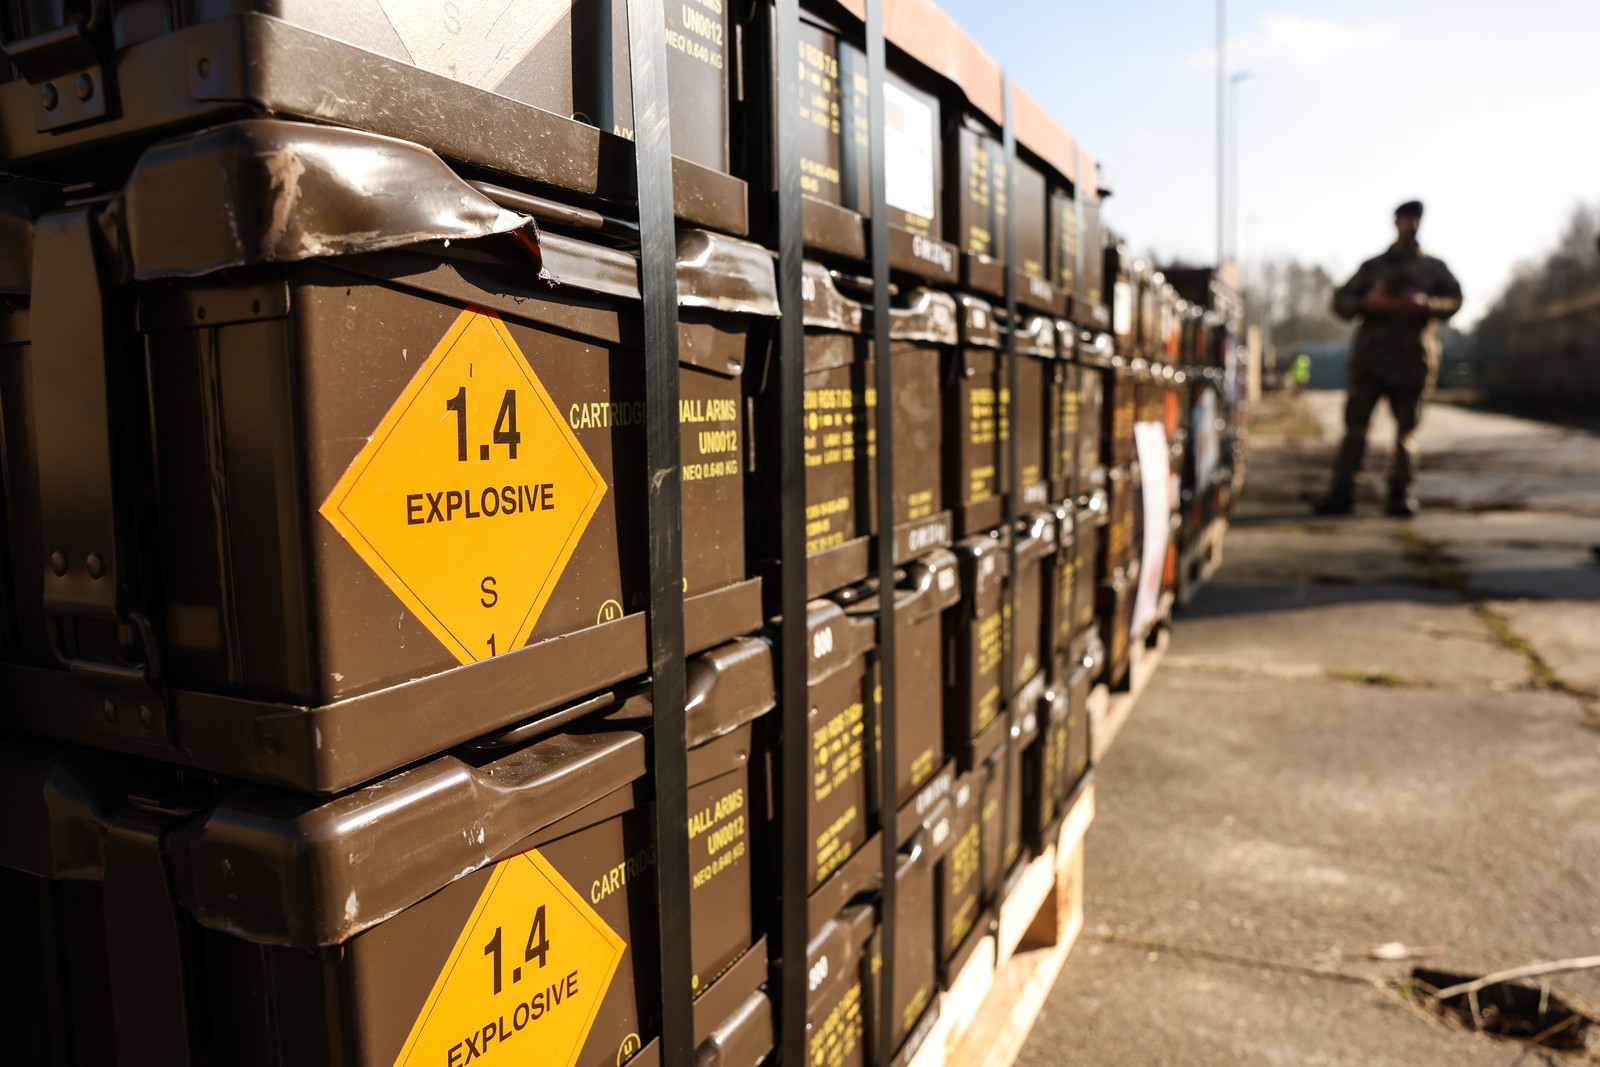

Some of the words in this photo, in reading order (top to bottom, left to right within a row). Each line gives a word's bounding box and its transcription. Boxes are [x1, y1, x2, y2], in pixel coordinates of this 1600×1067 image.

[665, 28, 685, 54] NEQ
[682, 4, 723, 46] UN0012
[446, 386, 521, 462] 1.4
[569, 399, 646, 430] CARTRIDG
[705, 398, 737, 422] ARMS
[698, 430, 738, 454] UN0012
[682, 464, 703, 481] NEQ
[406, 483, 555, 526] EXPLOSIVE
[480, 576, 498, 609] S
[486, 633, 497, 657] 1
[714, 788, 744, 824] ARMS
[707, 815, 745, 856] UN0012
[590, 843, 657, 905] CARTRIDG
[692, 862, 713, 891] NEQ
[483, 904, 551, 996] 1.4
[446, 970, 580, 1067] EXPLOSIVE
